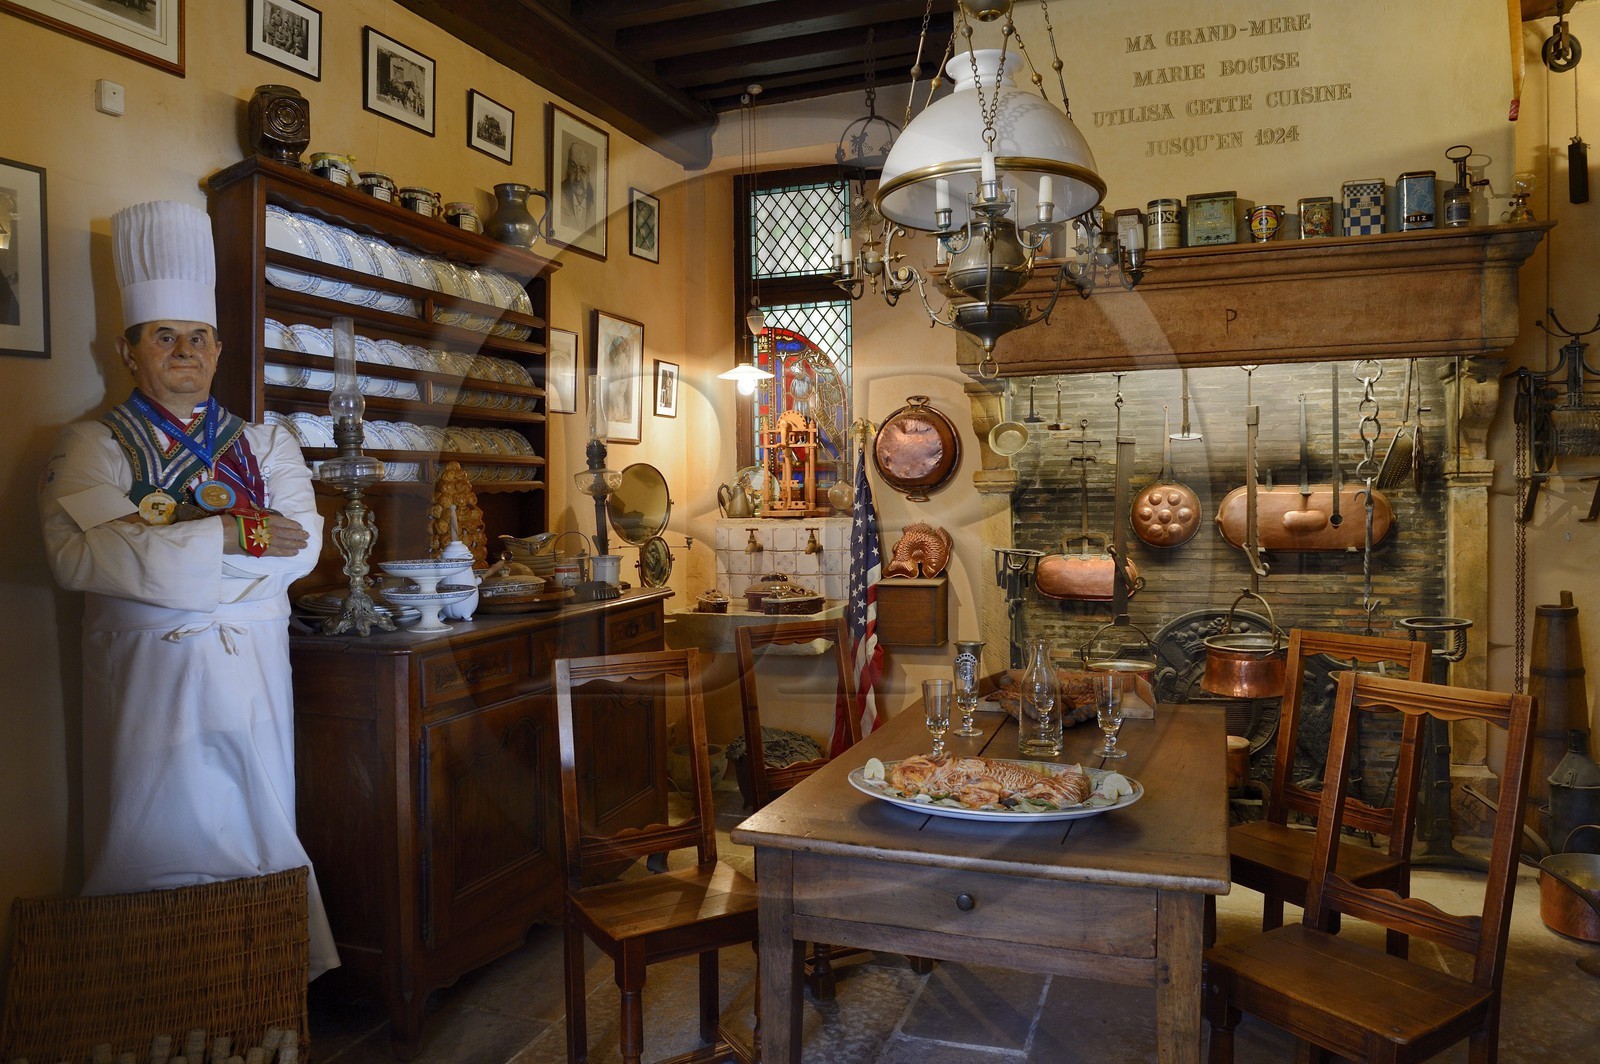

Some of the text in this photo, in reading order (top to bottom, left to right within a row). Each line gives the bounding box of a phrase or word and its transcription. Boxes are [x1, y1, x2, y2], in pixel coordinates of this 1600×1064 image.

[1124, 13, 1312, 54] MA GRAND-MERE
[1133, 51, 1300, 88] MARIE BOCUSE
[1091, 82, 1352, 129] UTILISA CETTE CUISINE
[1144, 125, 1300, 158] JUSQU'EN 1924
